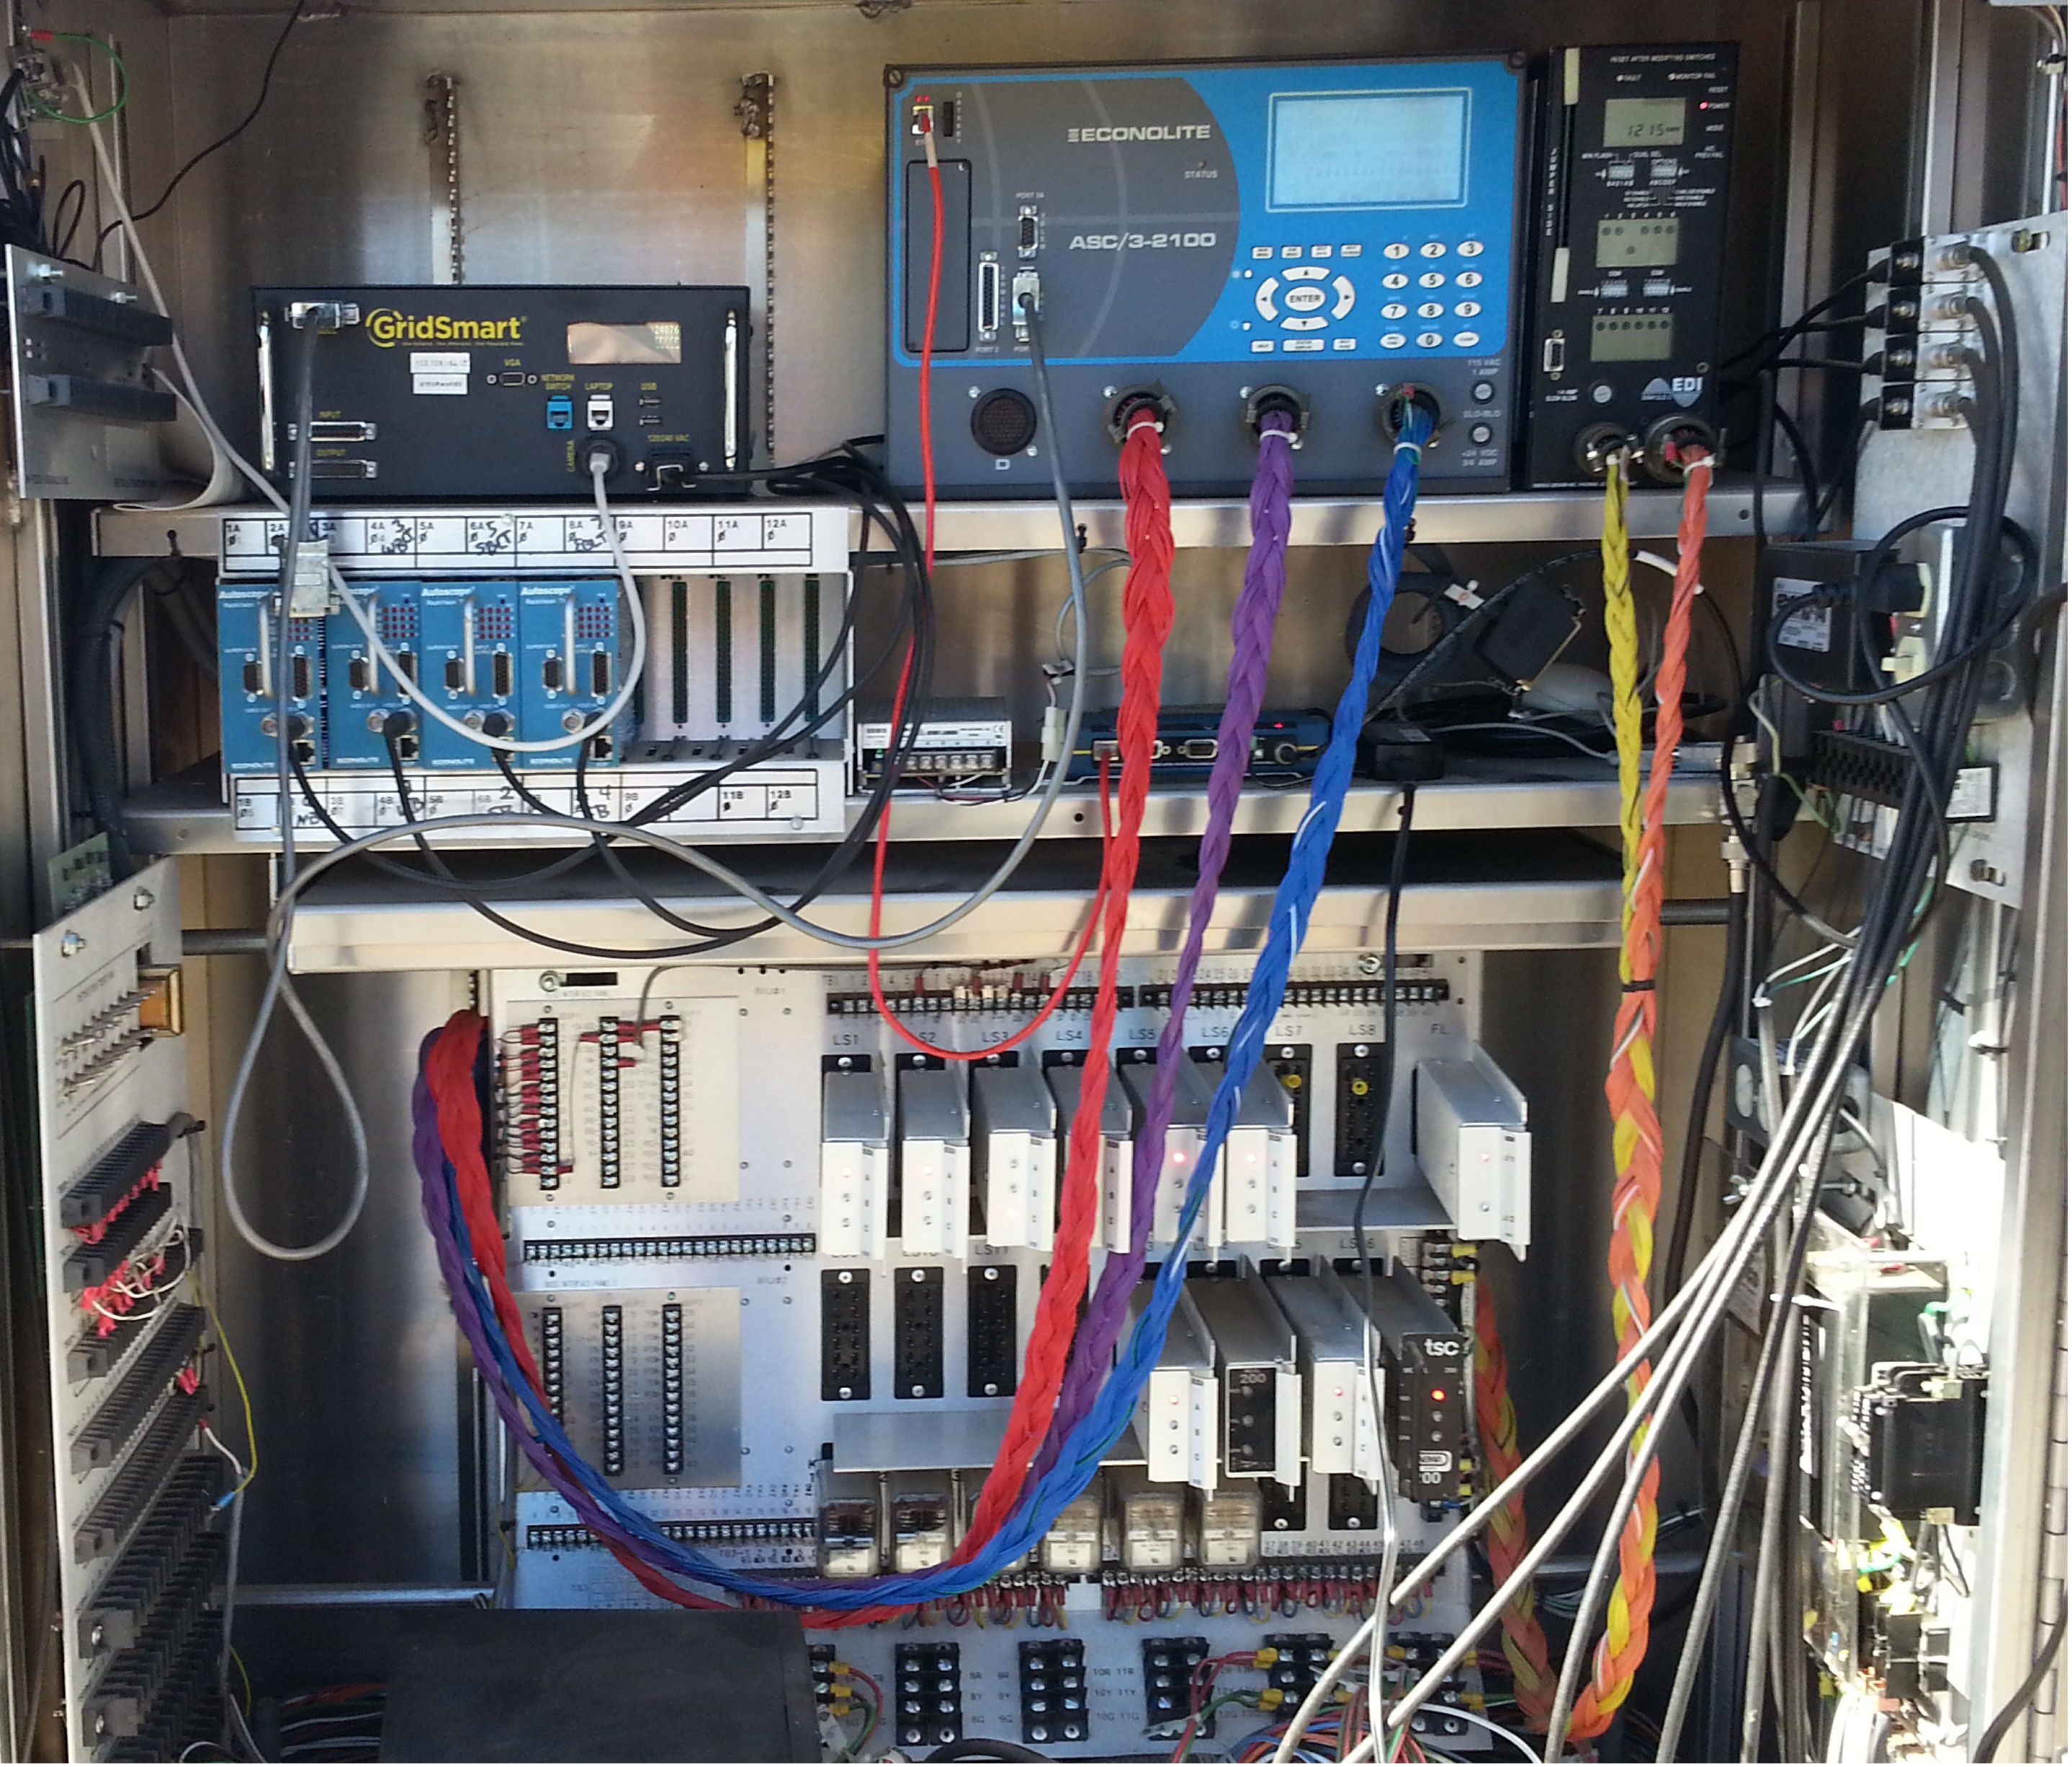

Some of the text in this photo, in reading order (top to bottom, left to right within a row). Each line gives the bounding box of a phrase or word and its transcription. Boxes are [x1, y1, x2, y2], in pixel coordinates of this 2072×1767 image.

[1081, 125, 1211, 143] ECONOLITE
[1184, 170, 1218, 180] STATUS
[1068, 233, 1217, 251] ASC/3-2100
[1394, 246, 1400, 256] 1
[1430, 244, 1437, 256] 2
[1467, 243, 1474, 254] 3
[1391, 276, 1399, 287] 4
[1429, 274, 1436, 286] 5
[1466, 273, 1473, 285] 6
[1289, 293, 1322, 304] ENTER
[1391, 306, 1397, 317] 7
[1427, 305, 1435, 316] 8
[1464, 304, 1471, 315] 9
[373, 315, 521, 339] GridSmart
[1426, 335, 1433, 346] 0
[640, 382, 658, 390] USB
[1672, 377, 1703, 392] EDI
[567, 440, 575, 472] CAMERA
[270, 523, 285, 532] 2A
[321, 522, 337, 531] 3A
[371, 522, 385, 530] 4A
[392, 519, 405, 533] 3
[420, 522, 434, 530] 5A
[470, 522, 485, 530] 6A
[486, 521, 498, 537] 5
[519, 521, 534, 529] 7A
[668, 520, 688, 529] 10A
[717, 520, 738, 529] 11A
[766, 519, 786, 528] 12A
[421, 587, 472, 596] Autoscope
[521, 587, 572, 596] Autoscope
[500, 786, 514, 800] 2
[599, 784, 611, 801] 4
[722, 790, 743, 800] 11B
[771, 789, 791, 800] 12B
[429, 795, 443, 804] 5B
[1129, 1028, 1157, 1040] LS5
[1201, 1026, 1229, 1038] LS6
[1275, 1025, 1302, 1037] LS7
[1349, 1024, 1376, 1036] LS8
[1430, 1023, 1448, 1035] FL
[833, 1034, 859, 1045] LS1
[981, 1031, 1009, 1042] LS3
[1056, 1029, 1083, 1041] LS4
[1424, 1338, 1460, 1356] tsc
[1239, 1374, 1267, 1384] 200
[1000, 1714, 1013, 1723] 9G
[1096, 1712, 1115, 1721] 10G
